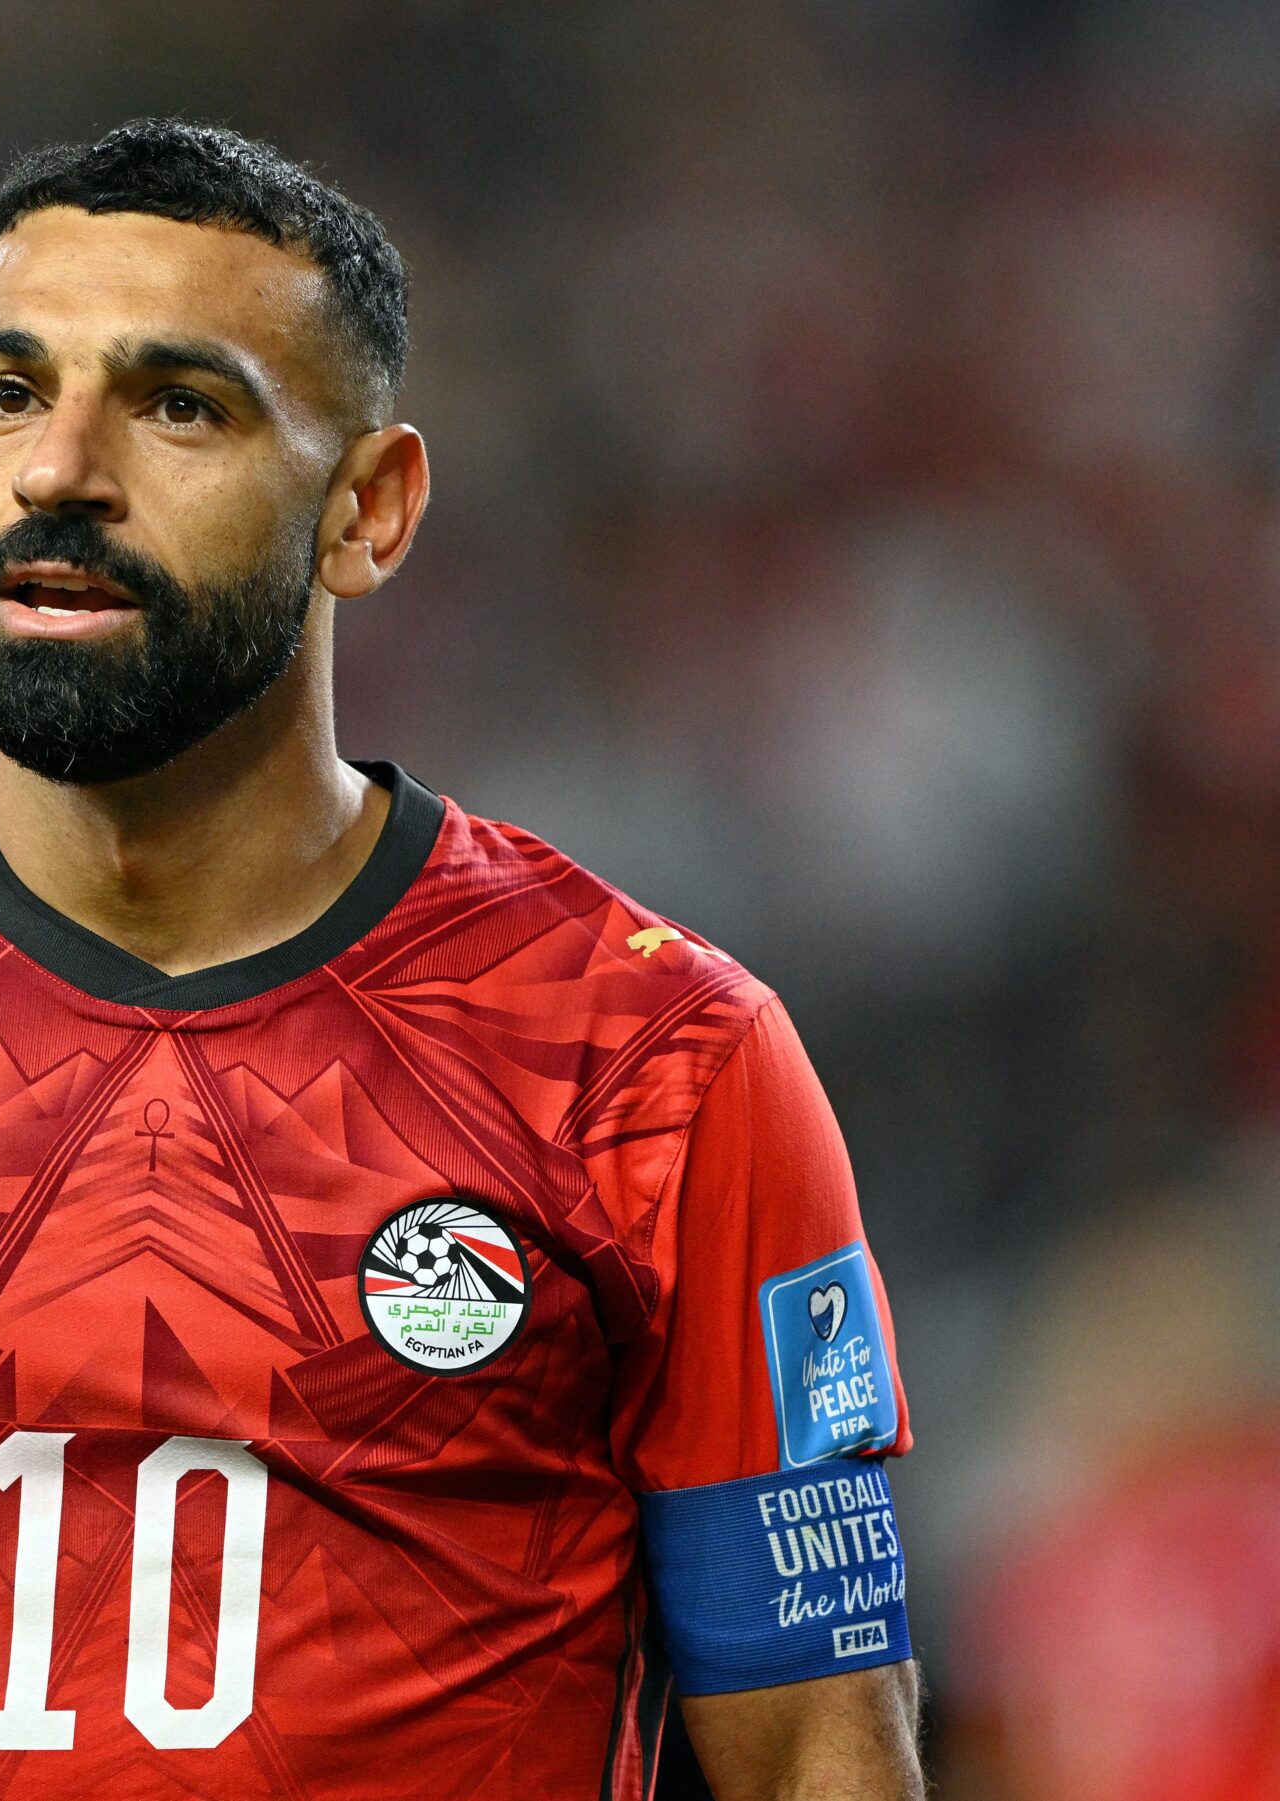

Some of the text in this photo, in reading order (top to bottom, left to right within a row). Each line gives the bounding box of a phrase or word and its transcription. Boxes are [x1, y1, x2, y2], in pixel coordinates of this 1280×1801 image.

[387, 1301, 506, 1319] الاتحاد المصري
[400, 1318, 494, 1340] لكرة القدم
[404, 1336, 484, 1359] EGYPTIAN FA
[802, 1335, 871, 1389] Unite For
[808, 1371, 878, 1423] PEACE
[830, 1414, 871, 1440] FIFA
[757, 1471, 890, 1527] FOOTBALL
[767, 1509, 898, 1578] UNITES
[768, 1581, 836, 1628] the
[839, 1625, 885, 1651] FIFA
